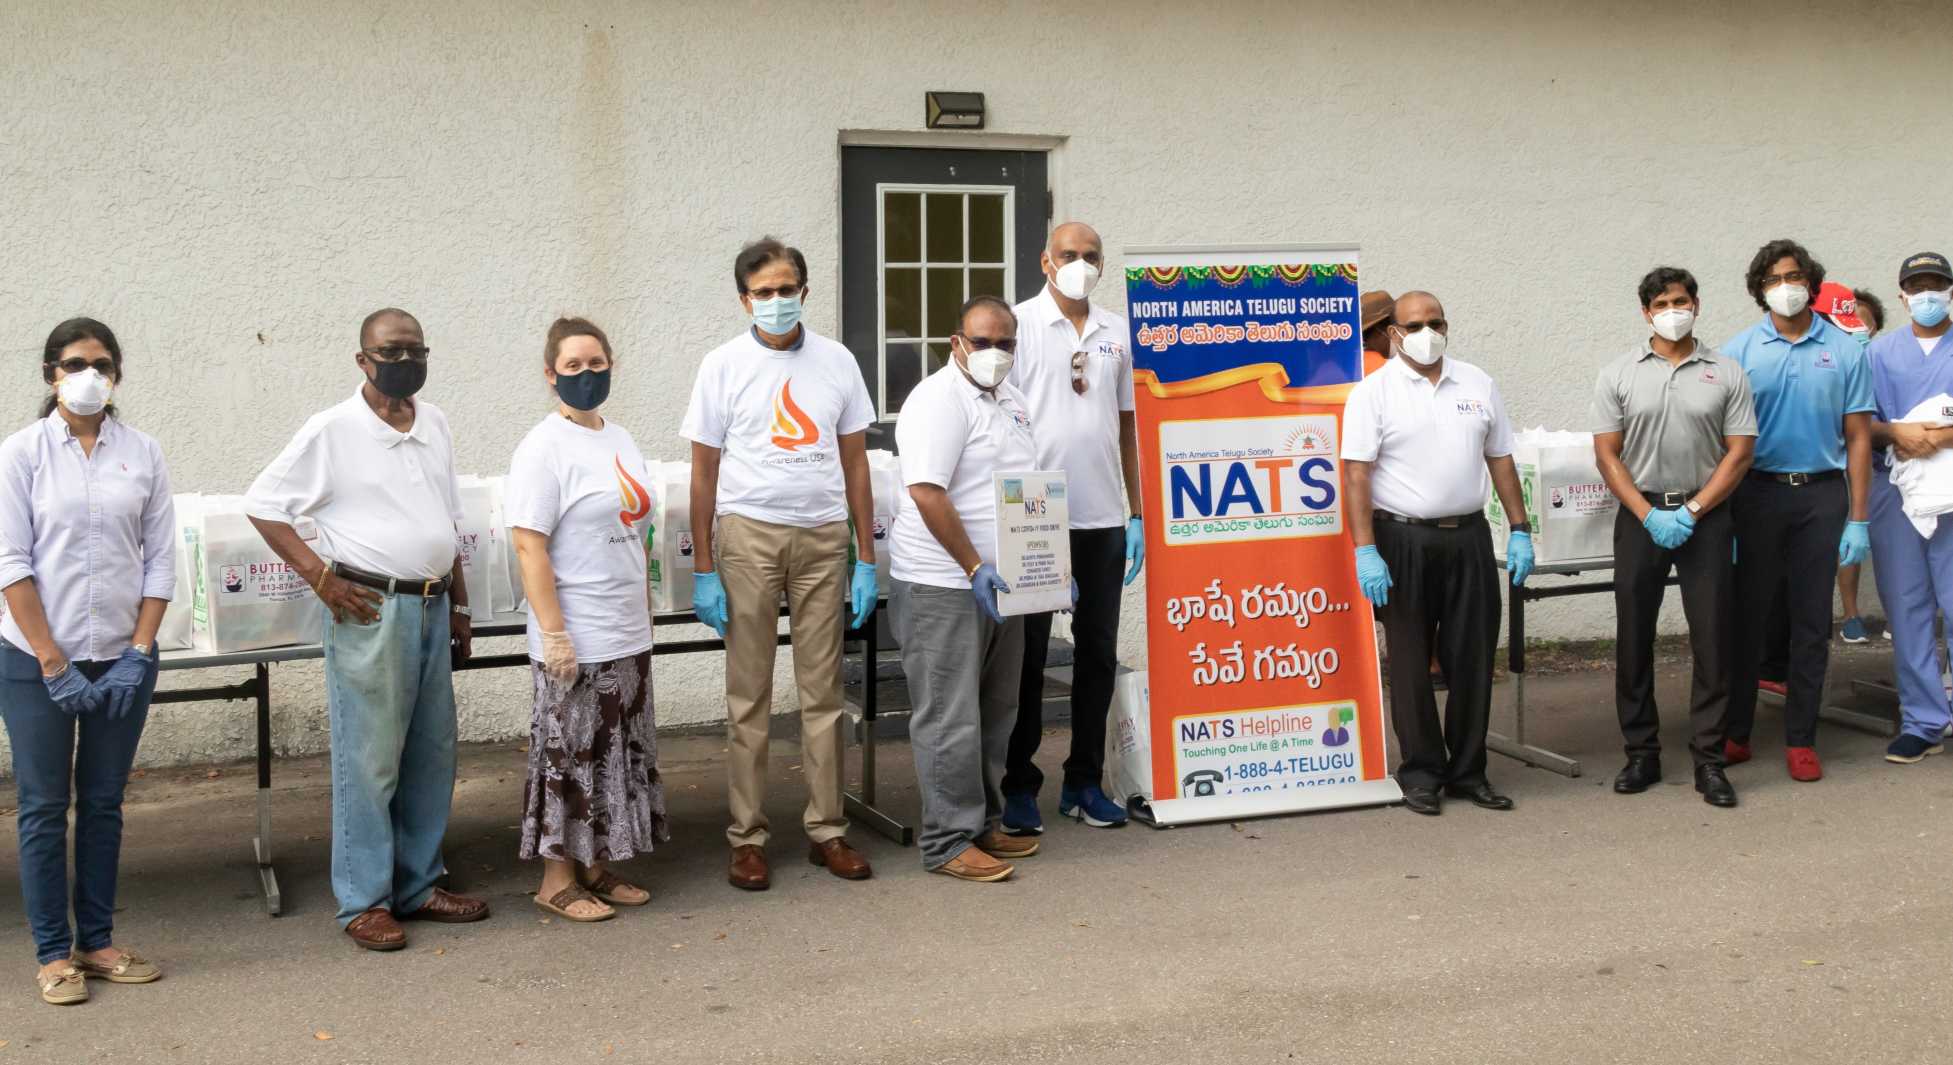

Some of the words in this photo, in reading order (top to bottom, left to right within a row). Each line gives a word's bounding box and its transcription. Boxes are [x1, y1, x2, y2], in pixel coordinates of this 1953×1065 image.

[1133, 301, 1177, 318] NORTH
[1182, 300, 1243, 316] AMERICA
[1247, 299, 1296, 315] TELUGU
[1300, 297, 1353, 314] SOCIETY
[1137, 323, 1177, 351] ఉత్తర
[1180, 322, 1244, 343] అమెరికా
[1246, 321, 1295, 342] తెలుగు
[1296, 320, 1352, 344] సంఘం
[1166, 451, 1187, 460] North
[1189, 450, 1219, 459] America
[1222, 448, 1246, 459] Telugu
[1248, 447, 1275, 457] Society
[1170, 457, 1335, 519] NATS
[1024, 500, 1046, 514] NATS
[1170, 522, 1200, 537] ఉత్తర
[1203, 520, 1250, 533] అమెరికా
[1254, 517, 1293, 530] తెలుగు
[1297, 514, 1334, 527] సంఘం
[249, 563, 291, 574] BUTTE
[249, 574, 296, 584] PHARM
[1166, 578, 1236, 632] భాషే
[1188, 640, 1246, 686] సేవే
[1253, 643, 1339, 689] గమ్యం
[1181, 718, 1235, 742] NATS
[1241, 713, 1313, 738] Helpline
[1183, 745, 1227, 759] Touching
[1228, 743, 1248, 754] One
[1250, 742, 1268, 752] Life
[1269, 740, 1280, 752] @
[1281, 739, 1289, 748] A
[1292, 736, 1314, 747] Time
[1223, 752, 1354, 781] 1-888-4-TELUGU
